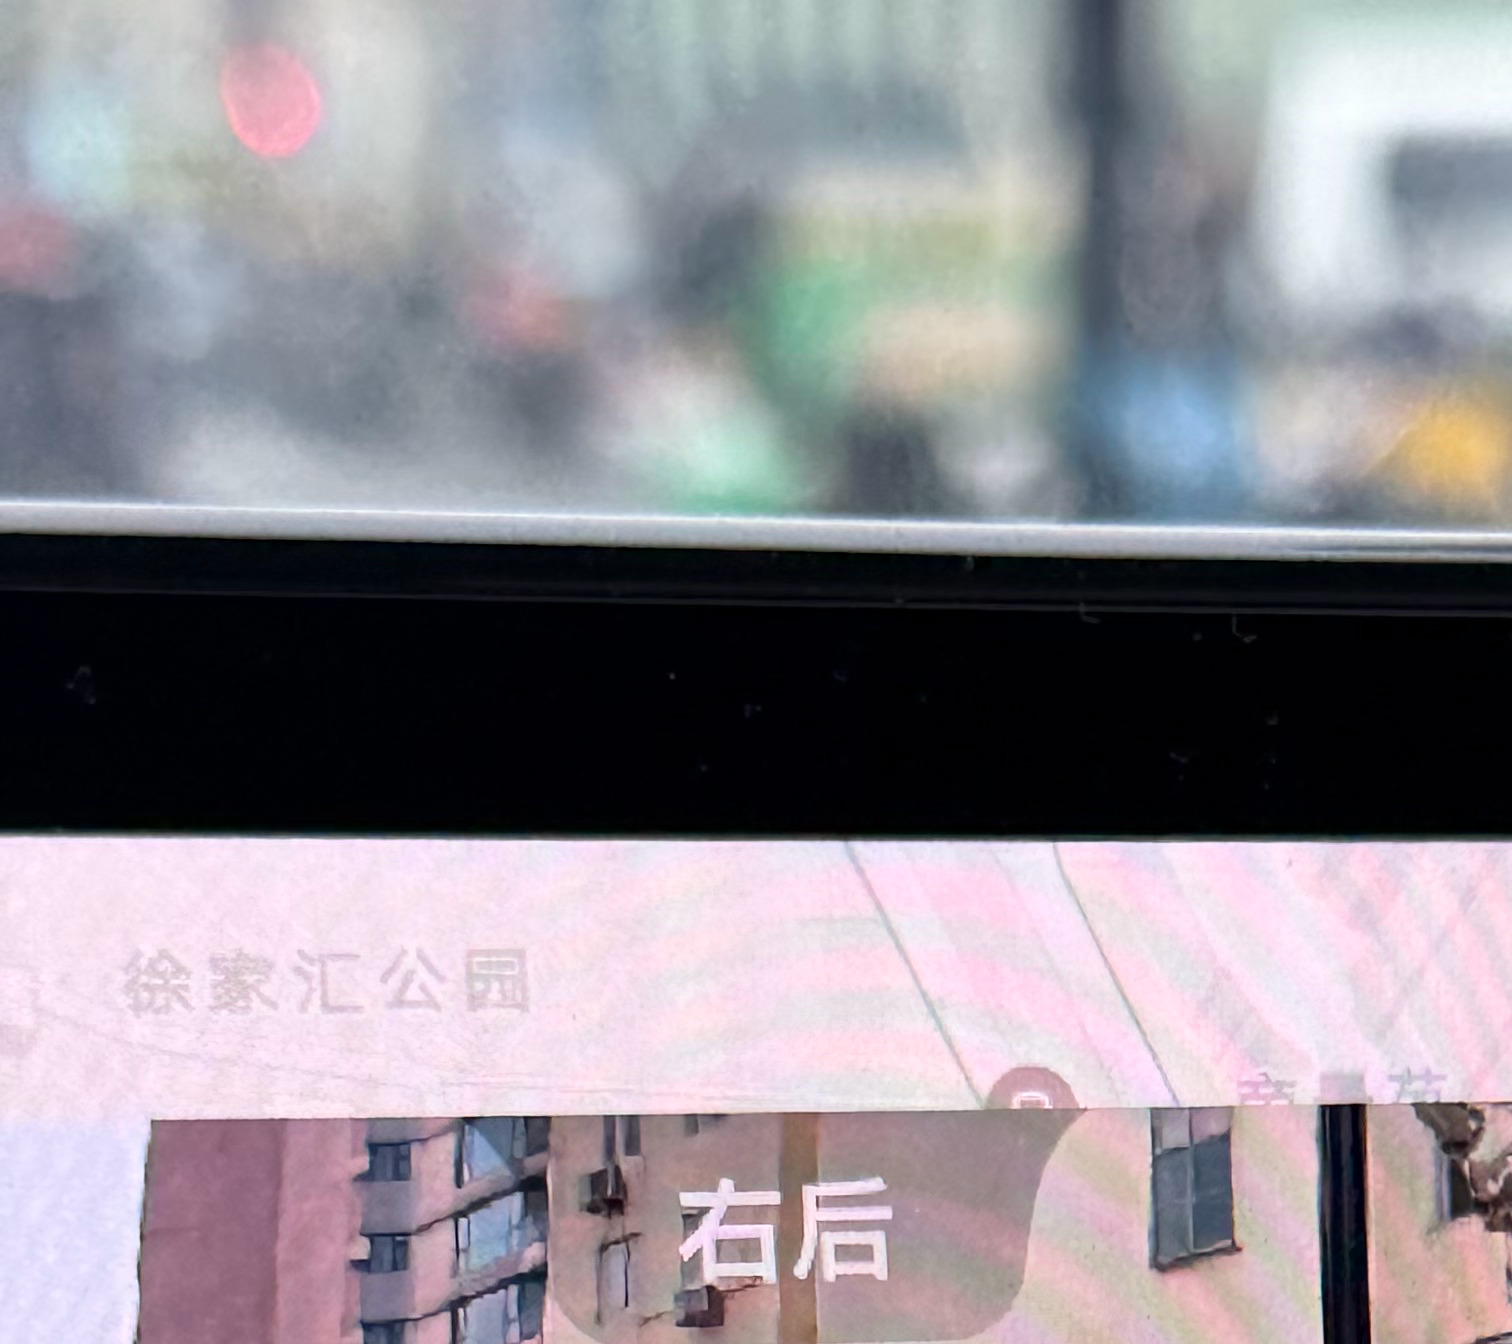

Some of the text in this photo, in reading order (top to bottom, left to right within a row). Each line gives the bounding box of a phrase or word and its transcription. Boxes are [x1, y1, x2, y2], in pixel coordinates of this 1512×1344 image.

[121, 946, 531, 1014] 徐家汇公园
[678, 1177, 894, 1284] 右后
